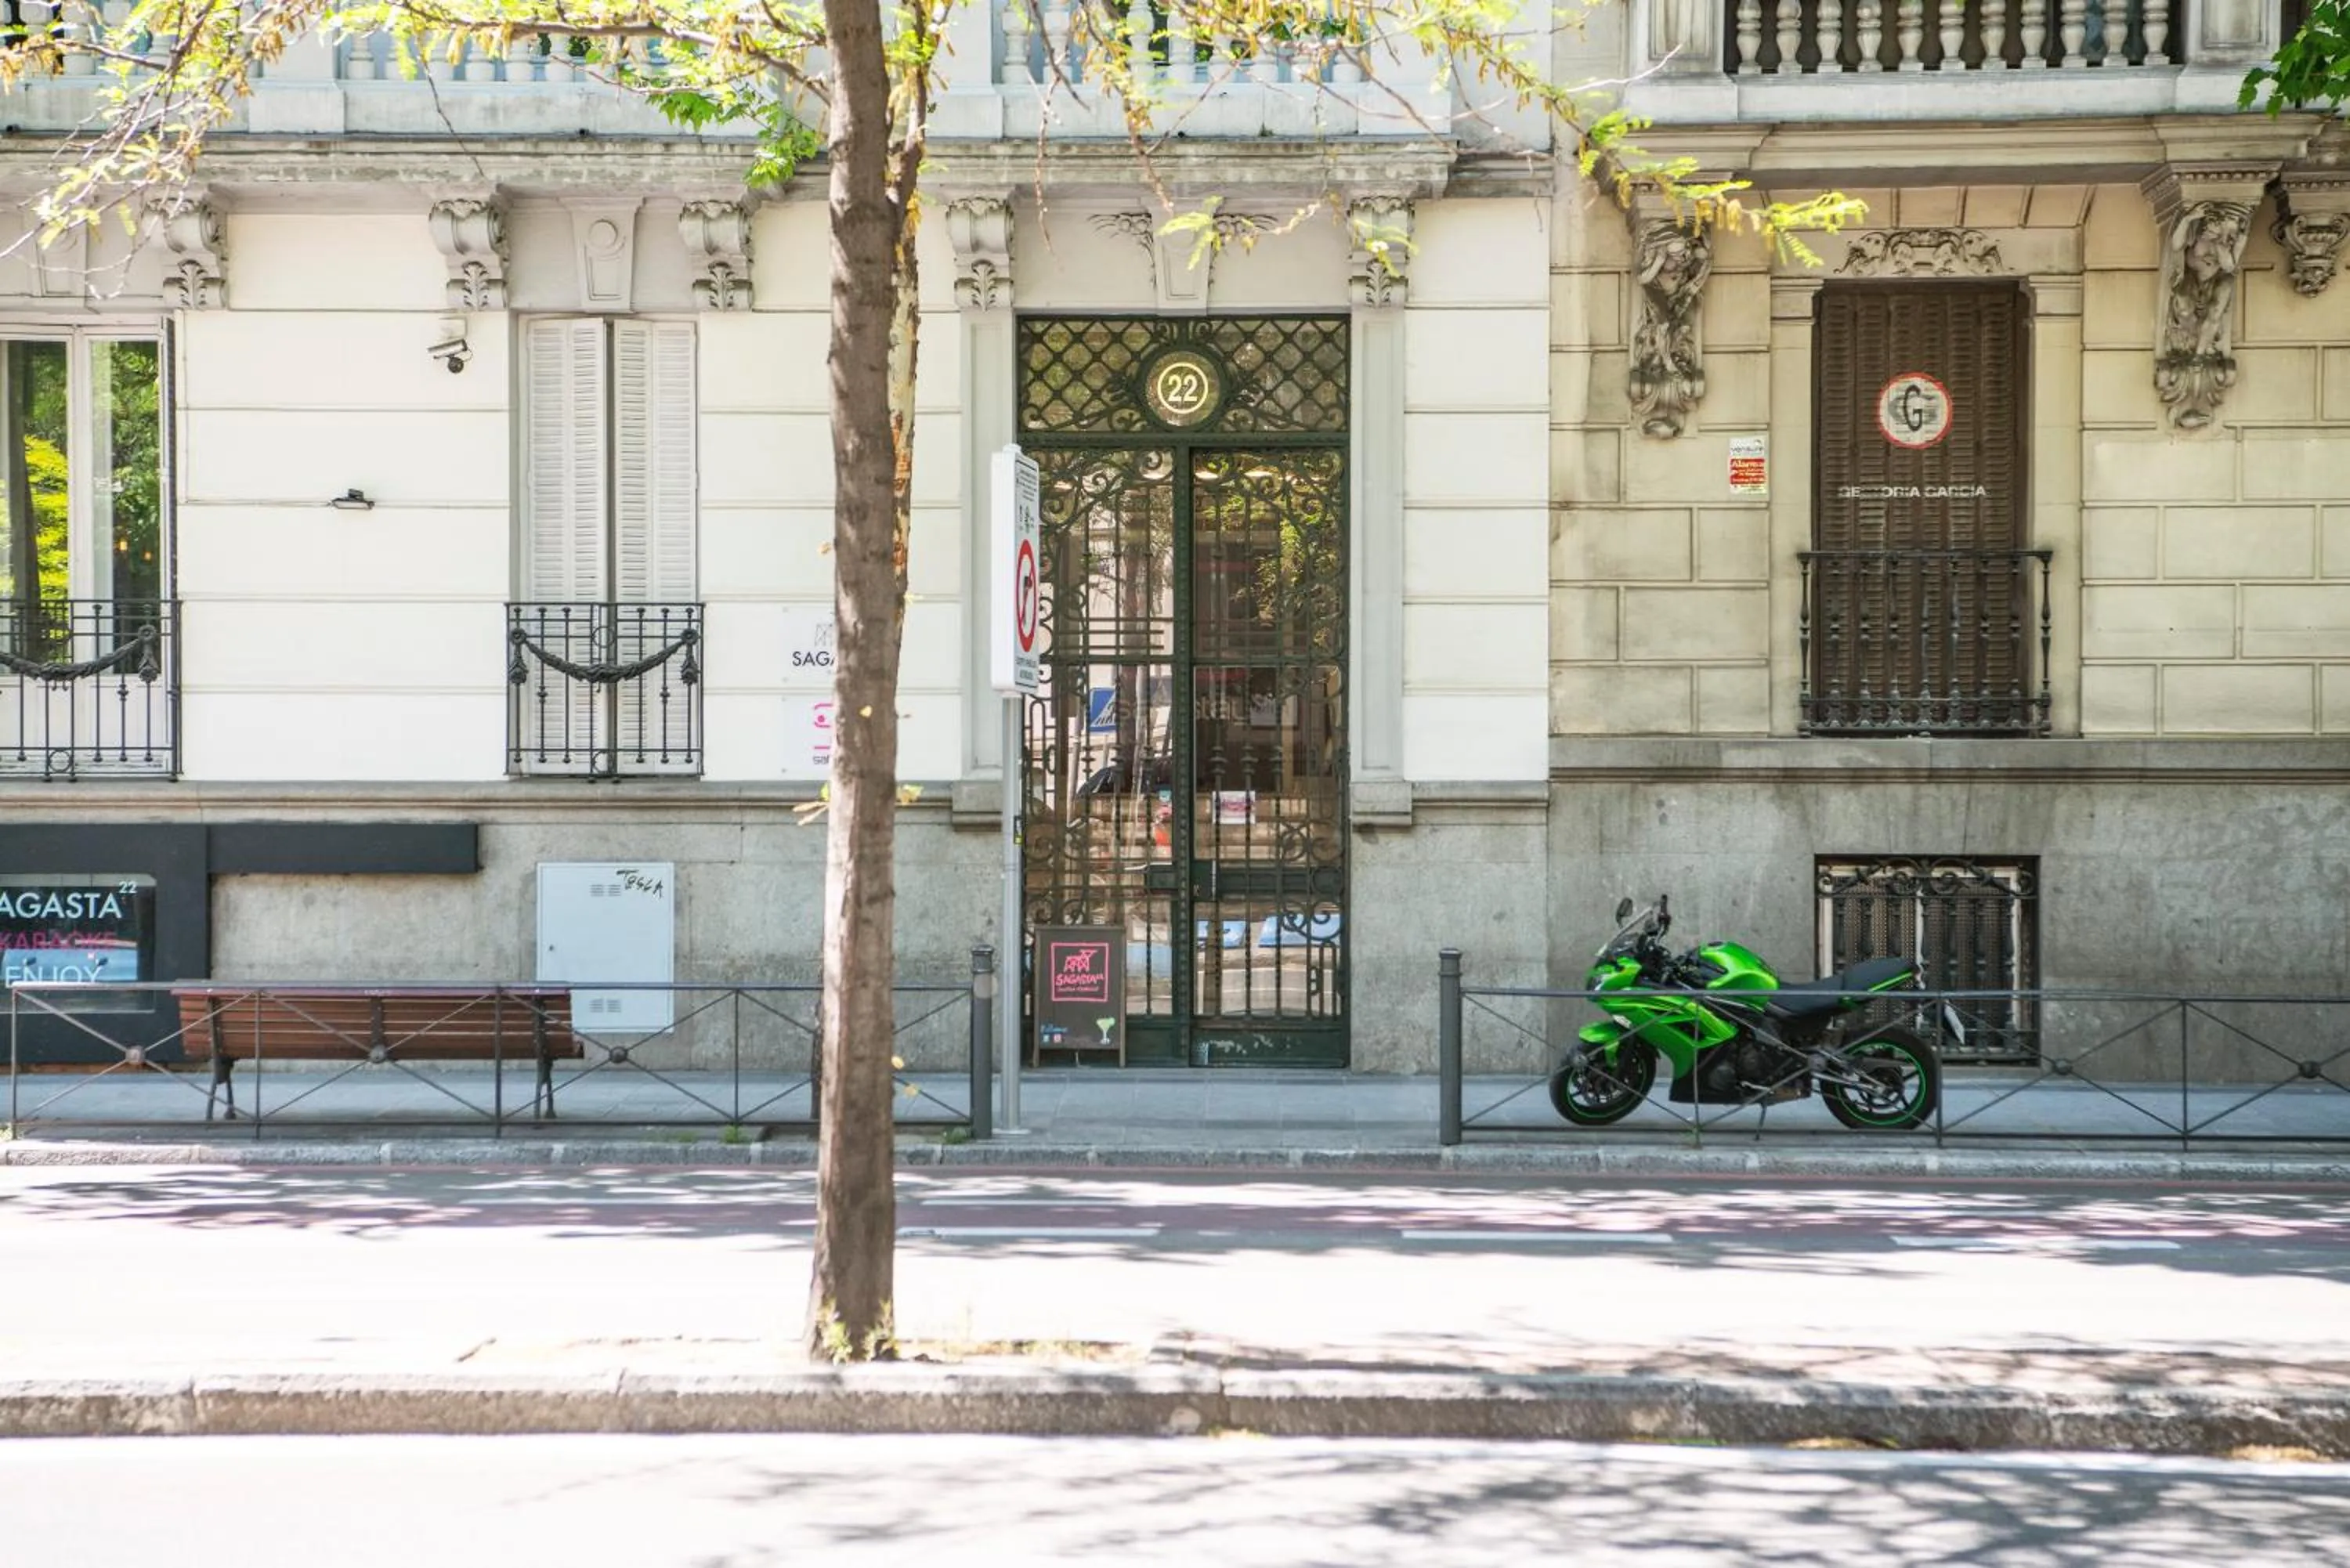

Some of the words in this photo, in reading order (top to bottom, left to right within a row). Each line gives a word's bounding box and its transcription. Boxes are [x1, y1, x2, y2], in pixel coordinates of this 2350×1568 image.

[1168, 374, 1197, 402] 22
[0, 892, 122, 919] AGASTA
[118, 881, 137, 894] 22
[5, 965, 103, 988] ENJOY
